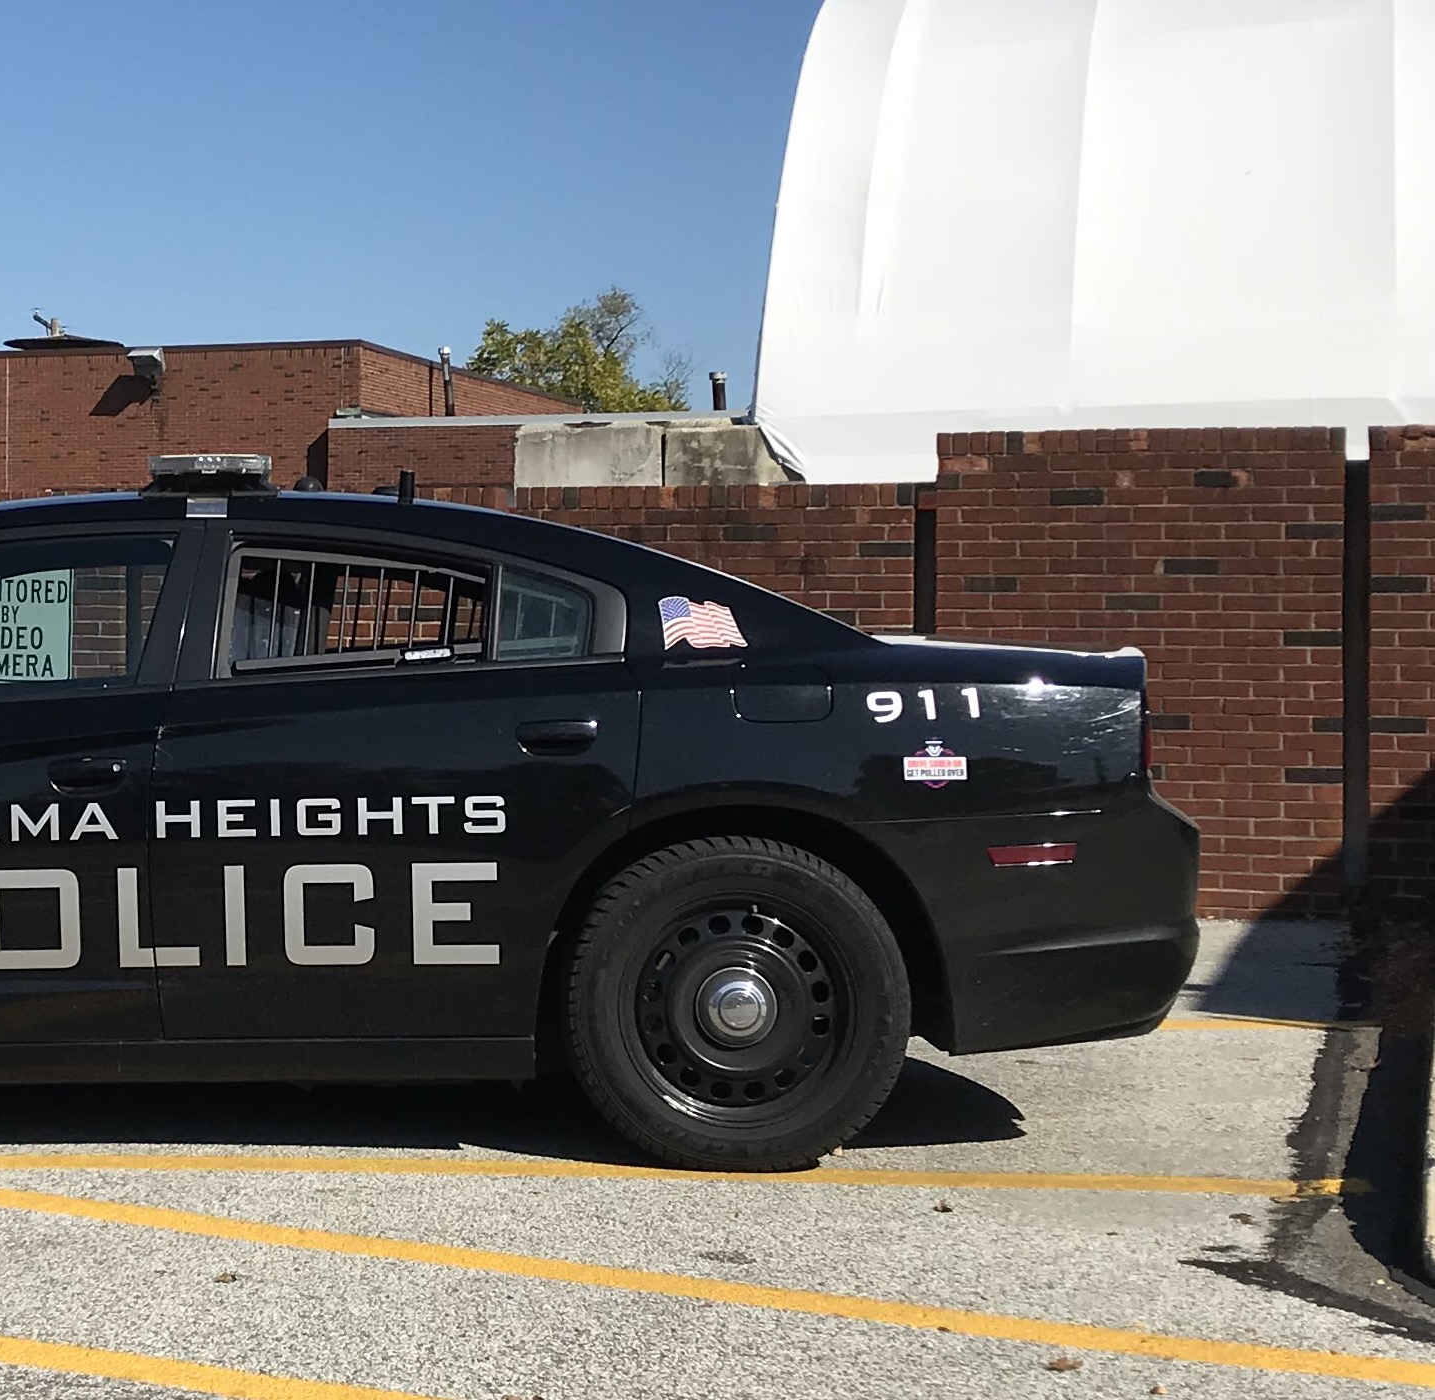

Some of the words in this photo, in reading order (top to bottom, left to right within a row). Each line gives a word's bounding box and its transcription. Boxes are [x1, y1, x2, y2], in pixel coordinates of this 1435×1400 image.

[2, 605, 20, 624] BY
[866, 687, 981, 723] 911
[906, 769, 919, 777] GET
[920, 769, 946, 777] PULLED
[947, 769, 965, 777] OVER
[155, 795, 508, 838] HEIGHTS
